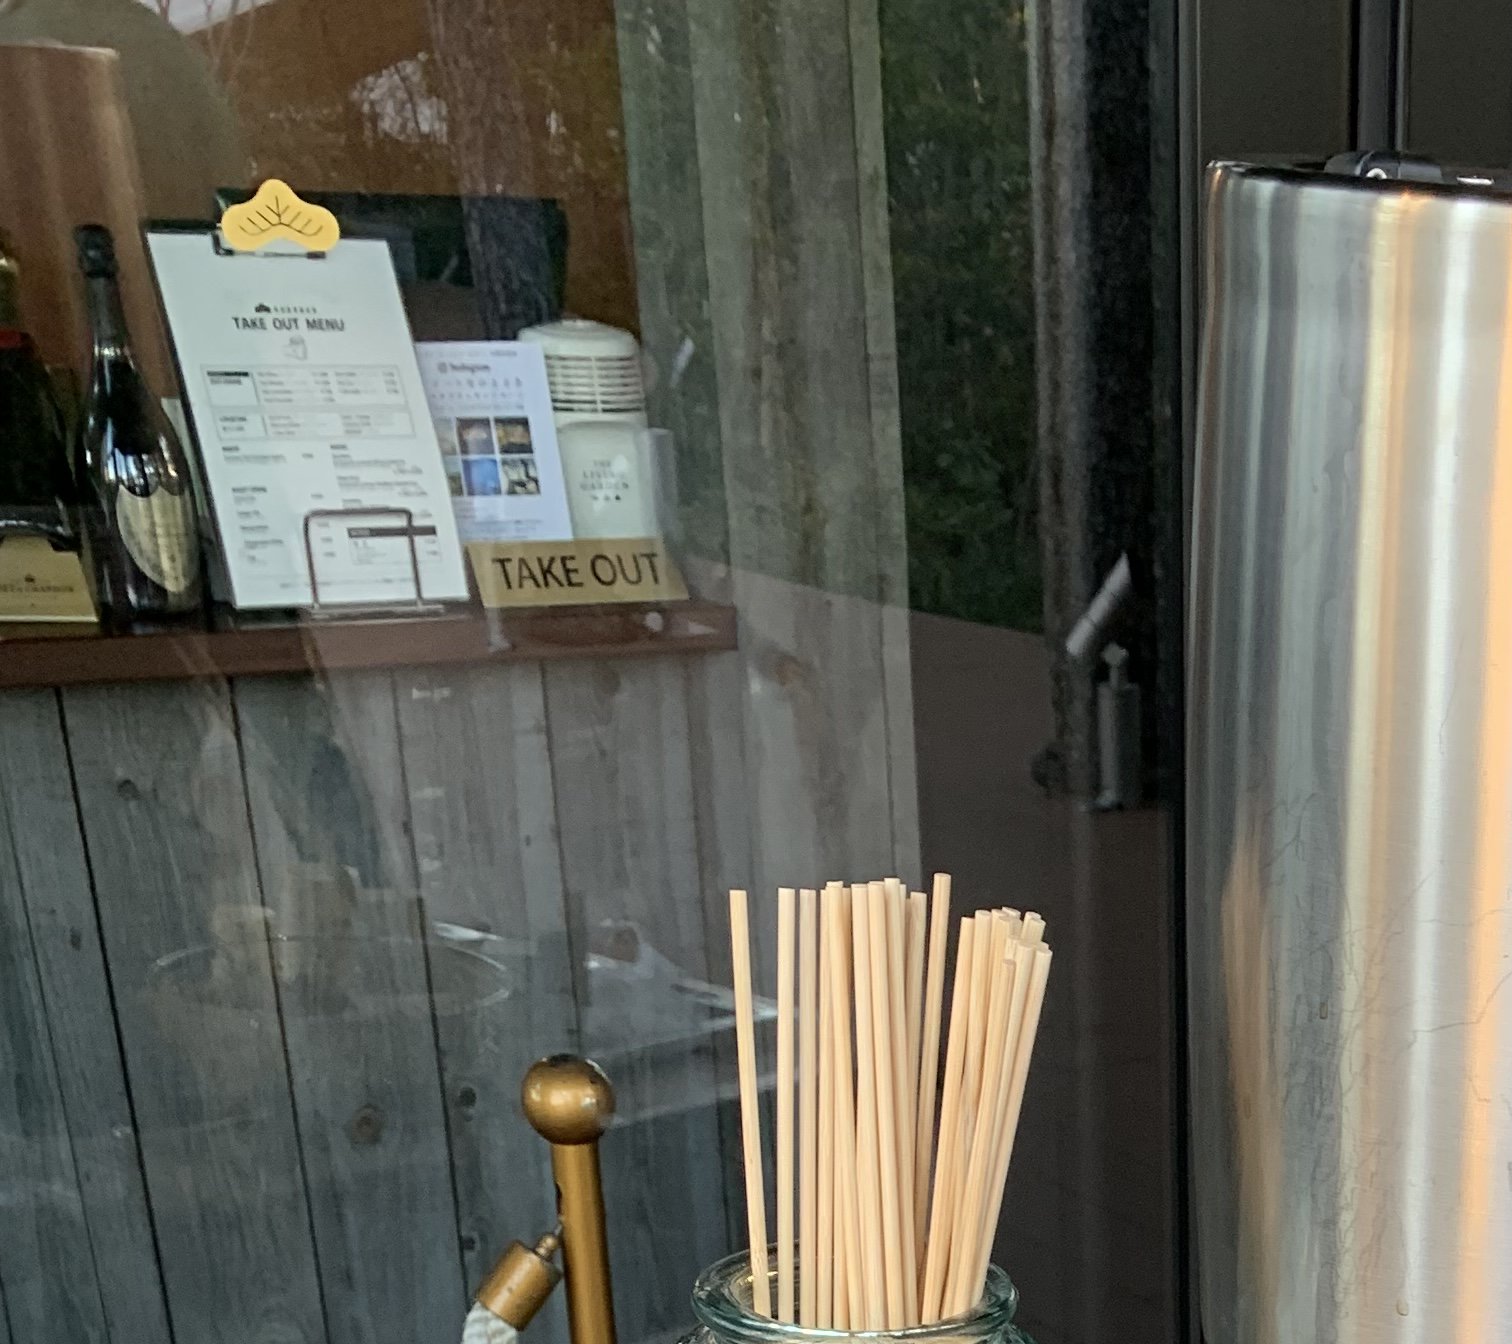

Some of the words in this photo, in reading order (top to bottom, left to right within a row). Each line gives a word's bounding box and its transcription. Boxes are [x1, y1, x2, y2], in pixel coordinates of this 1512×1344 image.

[232, 317, 267, 330] TAKE
[272, 318, 300, 330] OUT
[306, 318, 345, 331] MENU
[492, 555, 584, 589] TAKE
[590, 553, 659, 586] OUT
